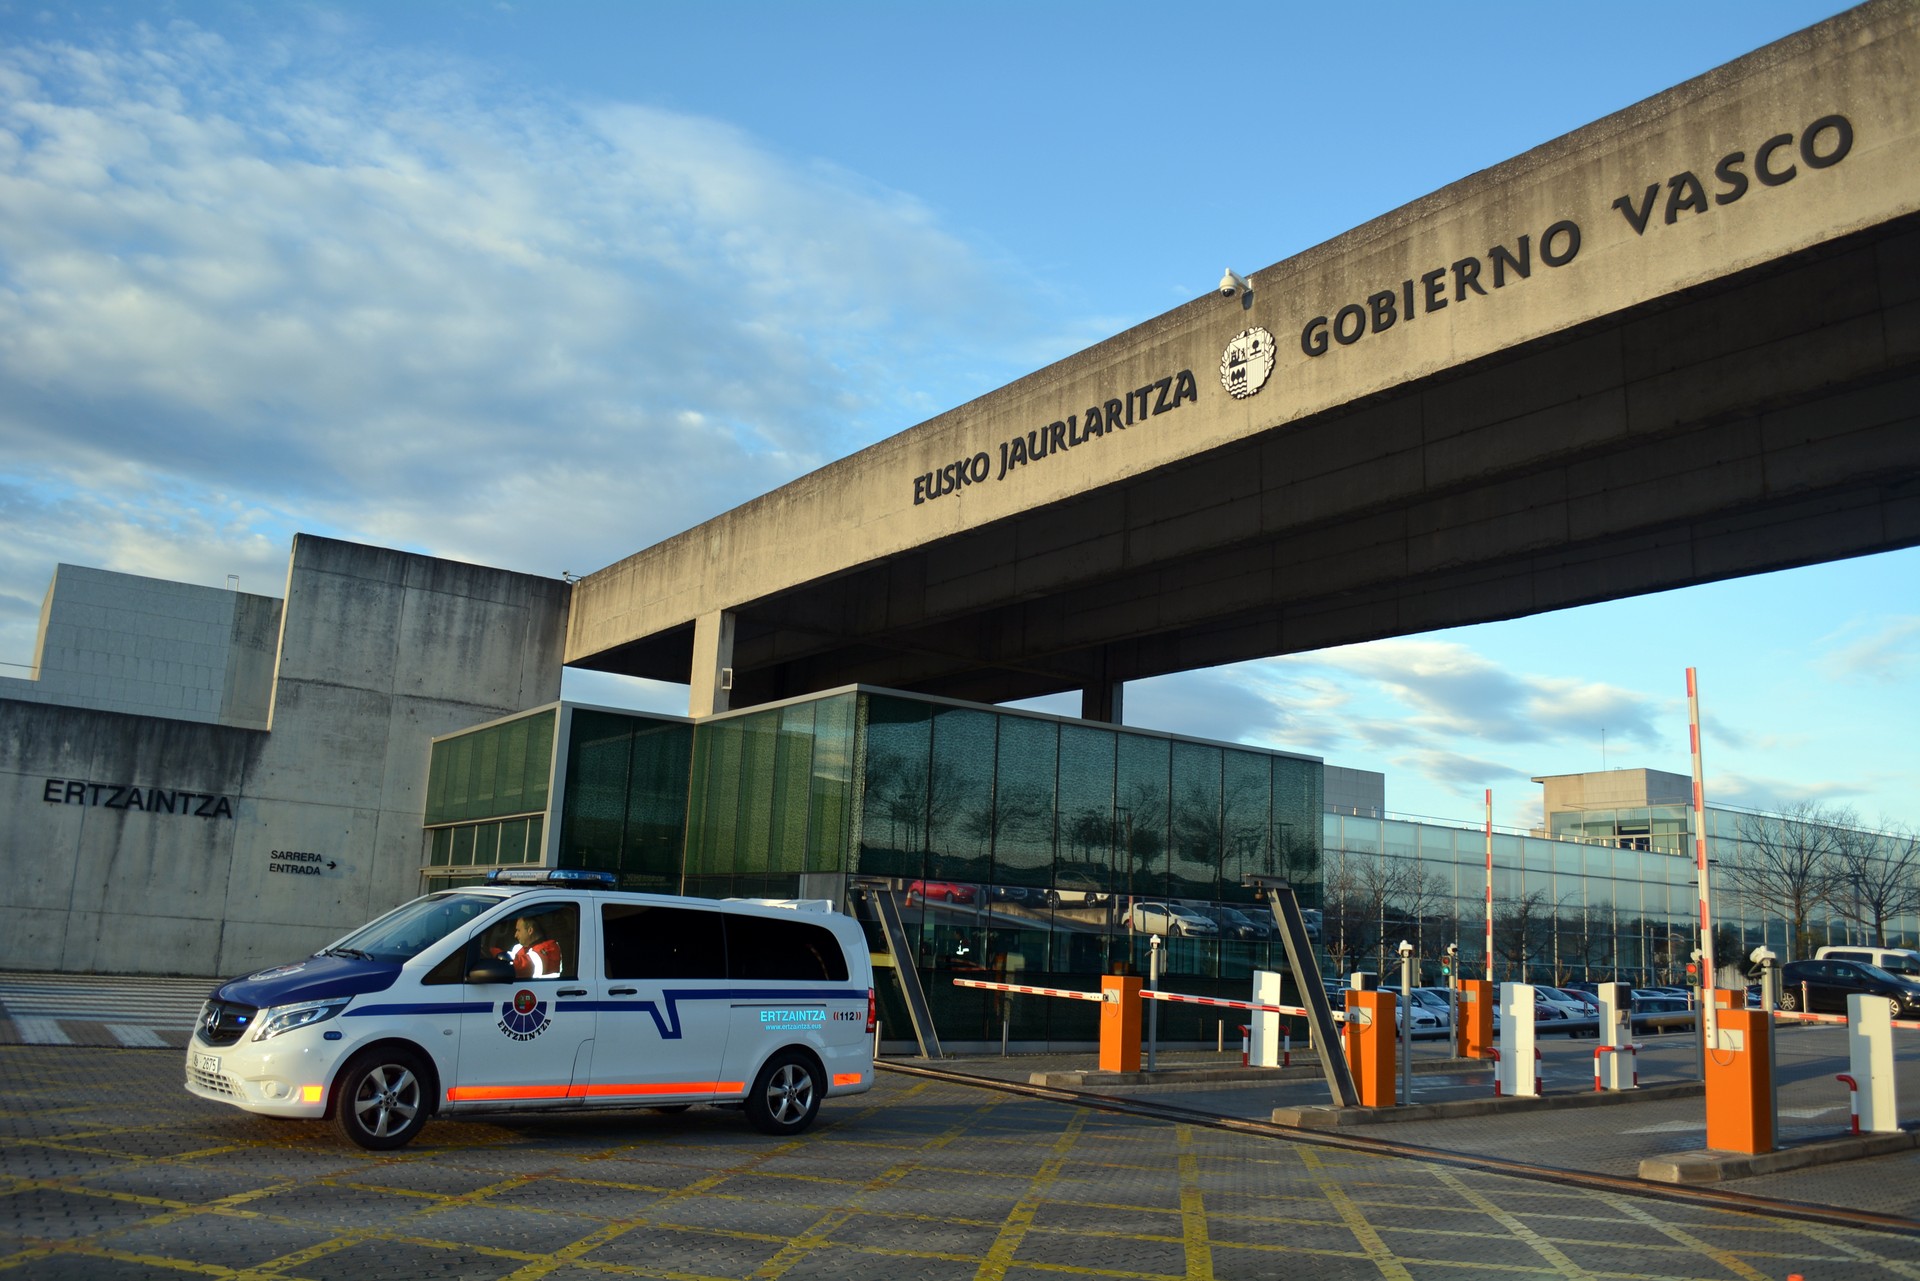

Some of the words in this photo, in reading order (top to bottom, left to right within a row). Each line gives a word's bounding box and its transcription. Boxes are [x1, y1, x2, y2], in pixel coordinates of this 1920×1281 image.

[1300, 219, 1582, 357] GOBIERNO
[1611, 114, 1854, 236] VASCO
[912, 451, 990, 506] EUSKO
[997, 368, 1198, 481] JAURLARITZA
[42, 778, 234, 819] ERTZAINTZA
[270, 850, 323, 863] SARRERA
[269, 863, 322, 876] ENTRADA
[760, 1010, 827, 1022] ERTZAINTZA
[497, 1018, 552, 1041] ERTZAINTZA
